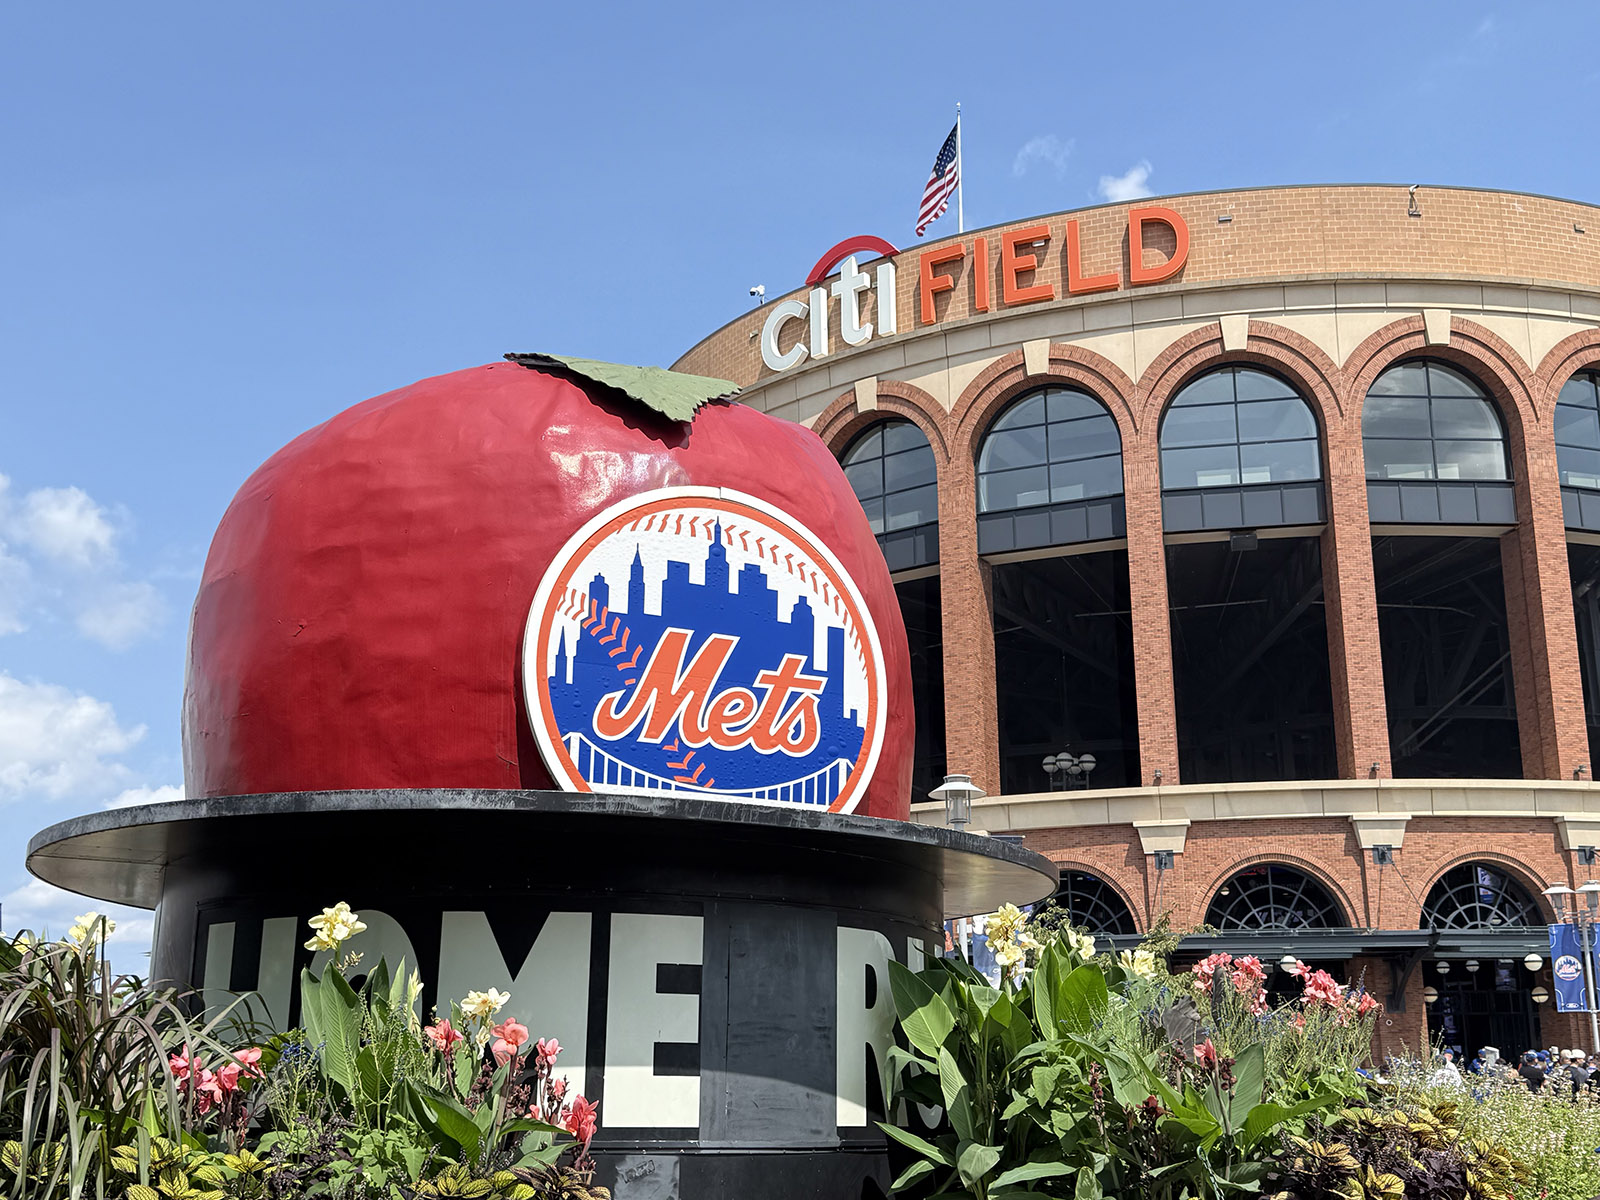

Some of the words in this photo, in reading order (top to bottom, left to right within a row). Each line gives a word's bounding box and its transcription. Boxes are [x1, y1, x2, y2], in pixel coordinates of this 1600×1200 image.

[761, 253, 896, 371] citi
[919, 207, 1190, 325] FIELD
[592, 627, 828, 757] Mets
